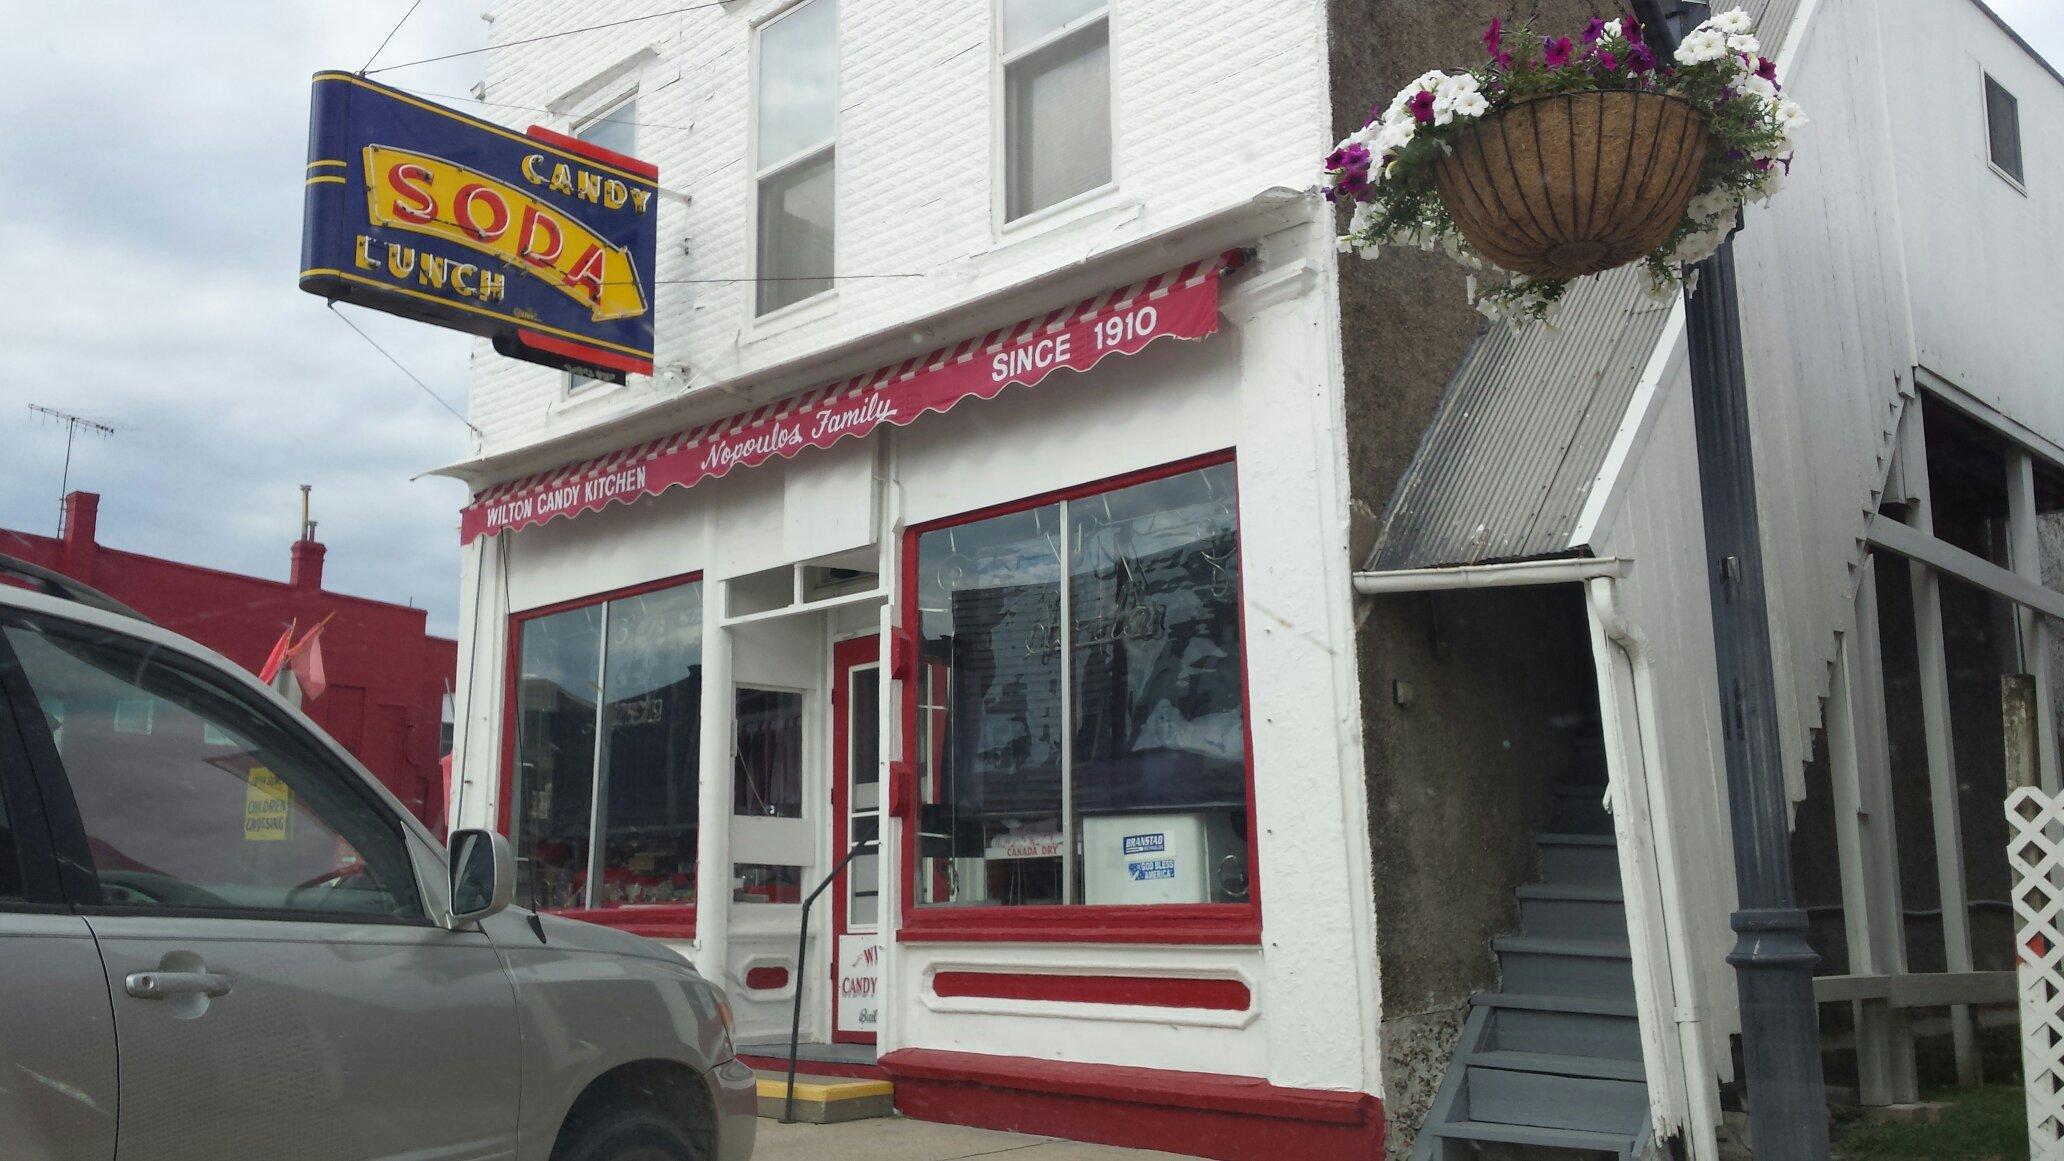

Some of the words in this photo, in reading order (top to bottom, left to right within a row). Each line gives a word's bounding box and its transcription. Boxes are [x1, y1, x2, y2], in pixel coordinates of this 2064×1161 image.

[521, 153, 652, 215] CANDY
[355, 234, 505, 302] LUNCH
[387, 163, 607, 308] SODA
[991, 333, 1071, 382] SINCE
[1094, 306, 1158, 350] 1910
[700, 421, 804, 468] Nopoulos
[811, 391, 898, 439] Family
[487, 498, 533, 528] WILTON
[537, 485, 580, 514] CANDY
[585, 466, 646, 503] KITCHEN
[1007, 846, 1038, 857] CANADA
[1042, 844, 1058, 855] DRY
[842, 977, 878, 997] CANDY
